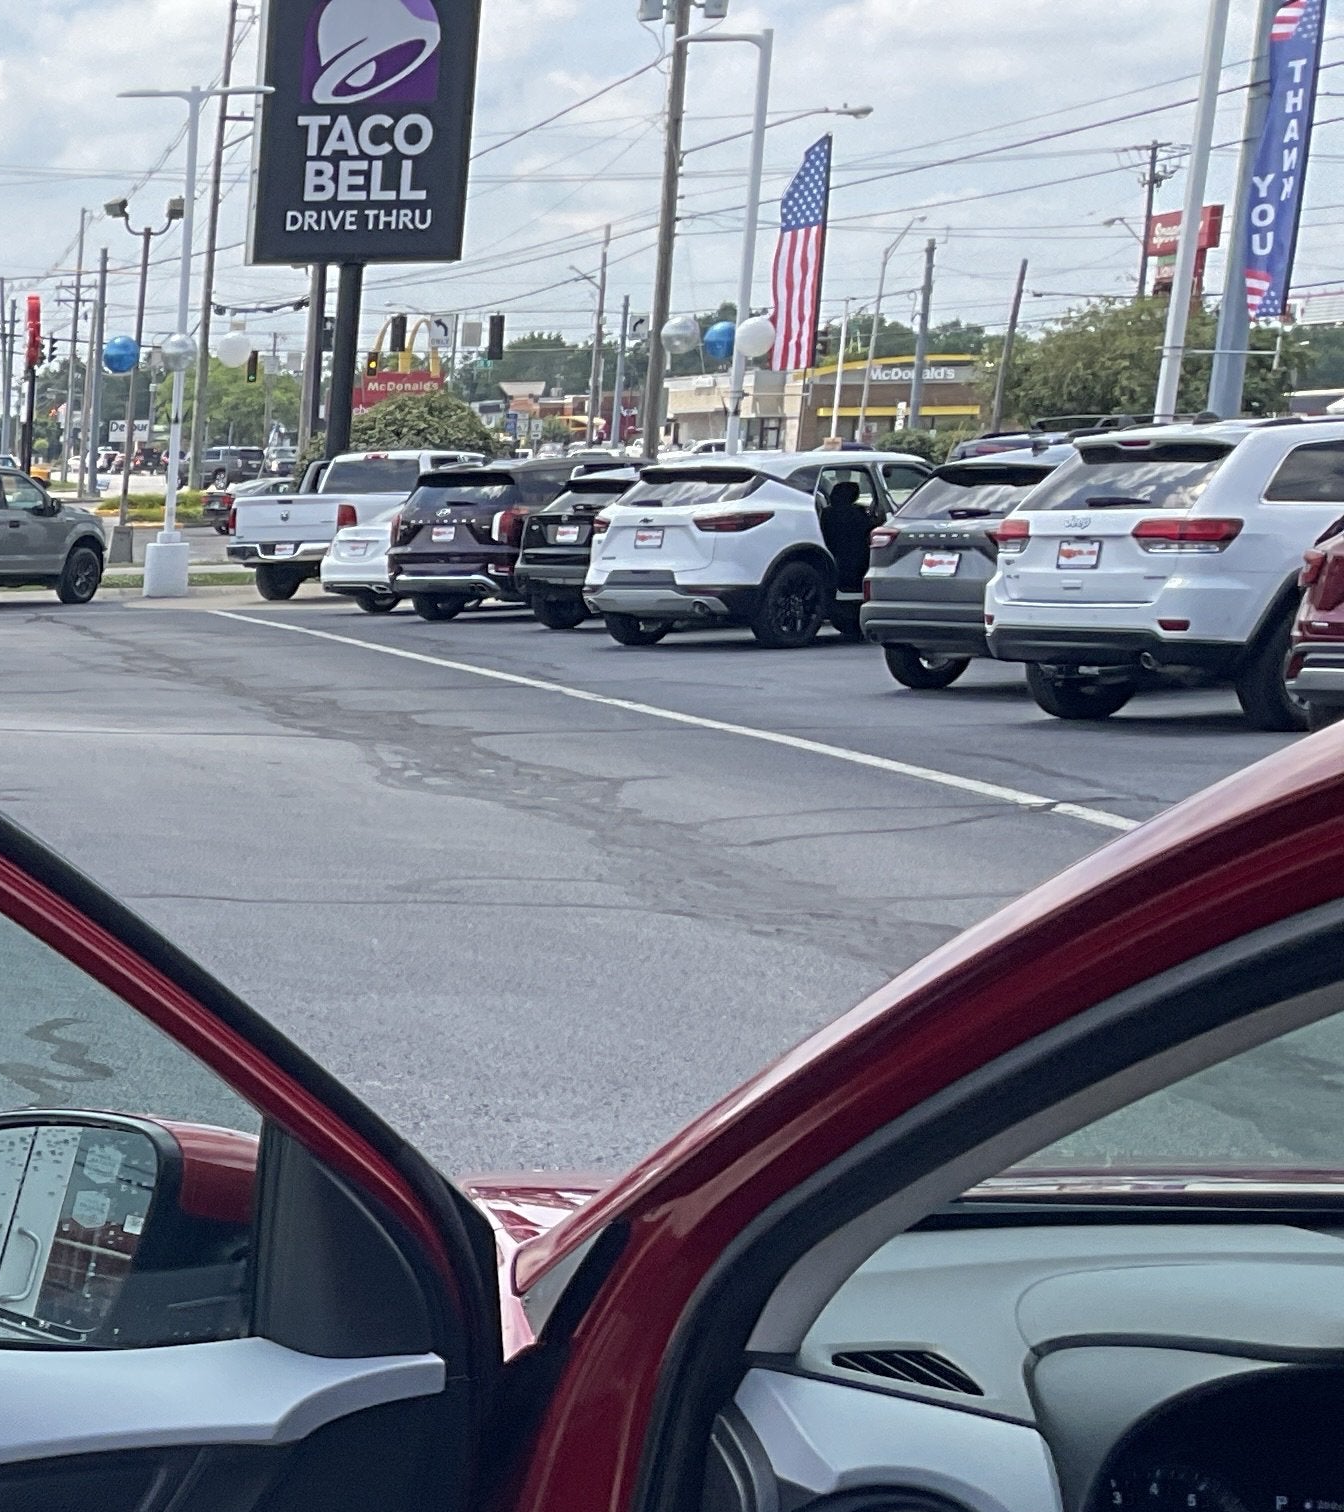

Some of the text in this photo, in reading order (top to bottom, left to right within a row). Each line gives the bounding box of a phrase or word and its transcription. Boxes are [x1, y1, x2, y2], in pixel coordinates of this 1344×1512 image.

[297, 113, 434, 157] TACO
[303, 160, 427, 202] BELL
[285, 208, 433, 232] DRIVE THRU
[870, 367, 955, 380] McDoald's
[1275, 1495, 1288, 1510] P
